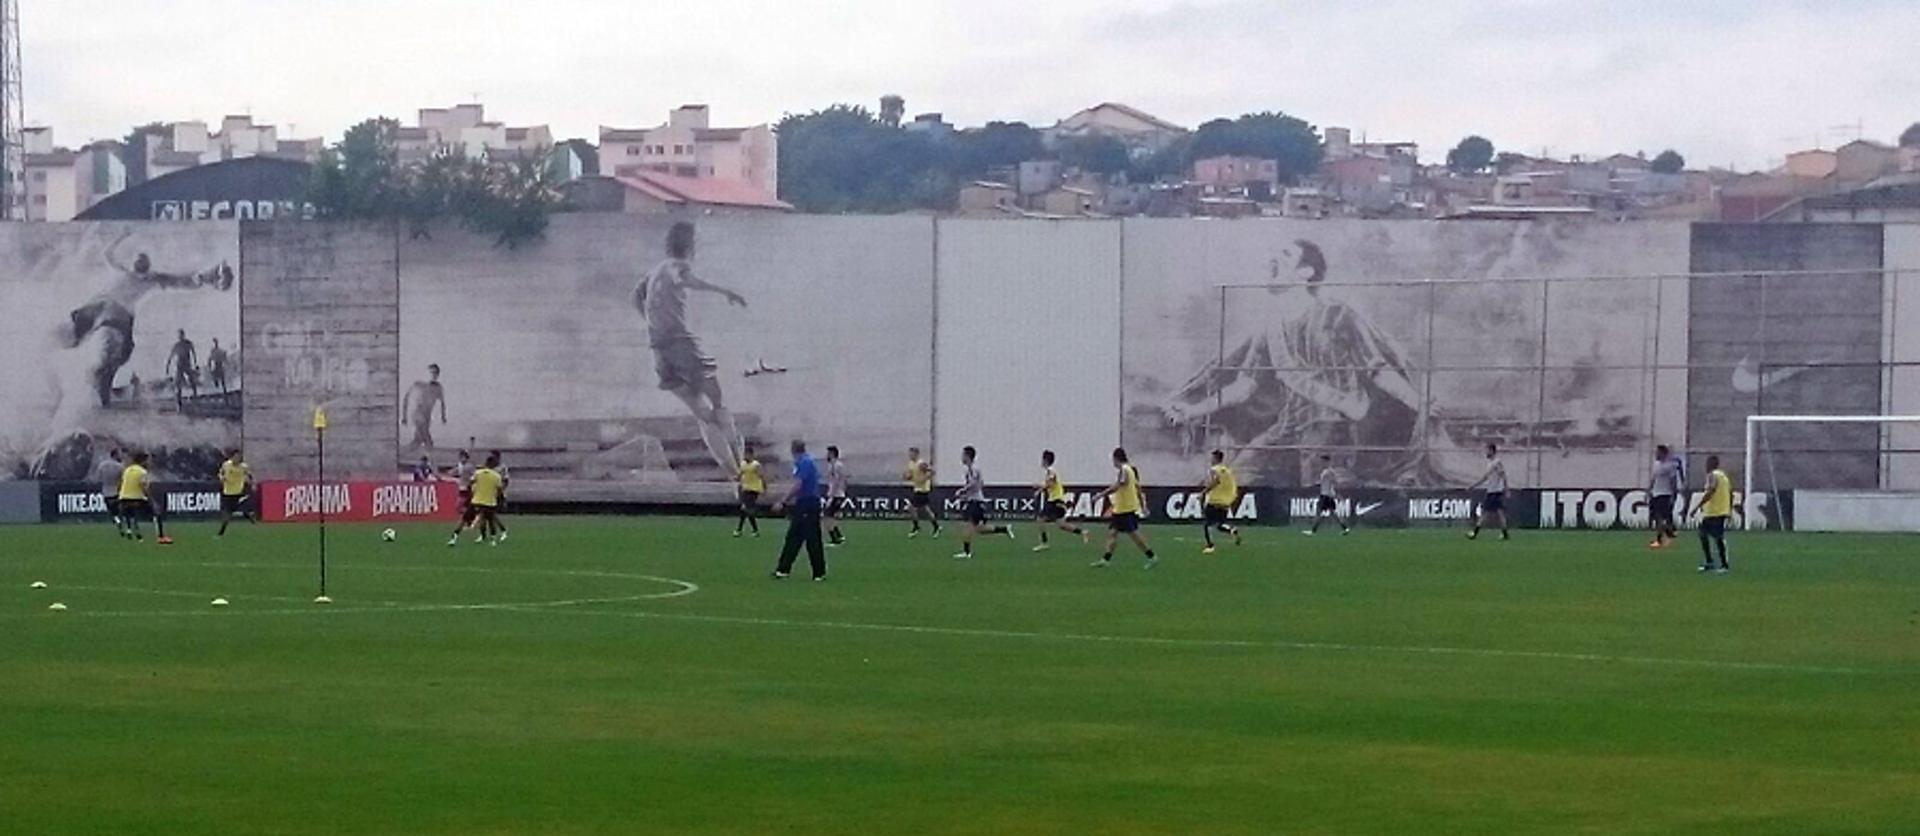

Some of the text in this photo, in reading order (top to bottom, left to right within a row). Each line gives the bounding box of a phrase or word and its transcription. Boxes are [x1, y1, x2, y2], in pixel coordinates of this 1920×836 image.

[59, 493, 107, 512] NIKE.CO
[167, 492, 220, 511] NIKE.COM
[372, 485, 438, 517] BRAHMA
[944, 498, 1035, 511] MRIX
[1166, 493, 1257, 519] CAA
[1409, 500, 1471, 518] NIKE.COM
